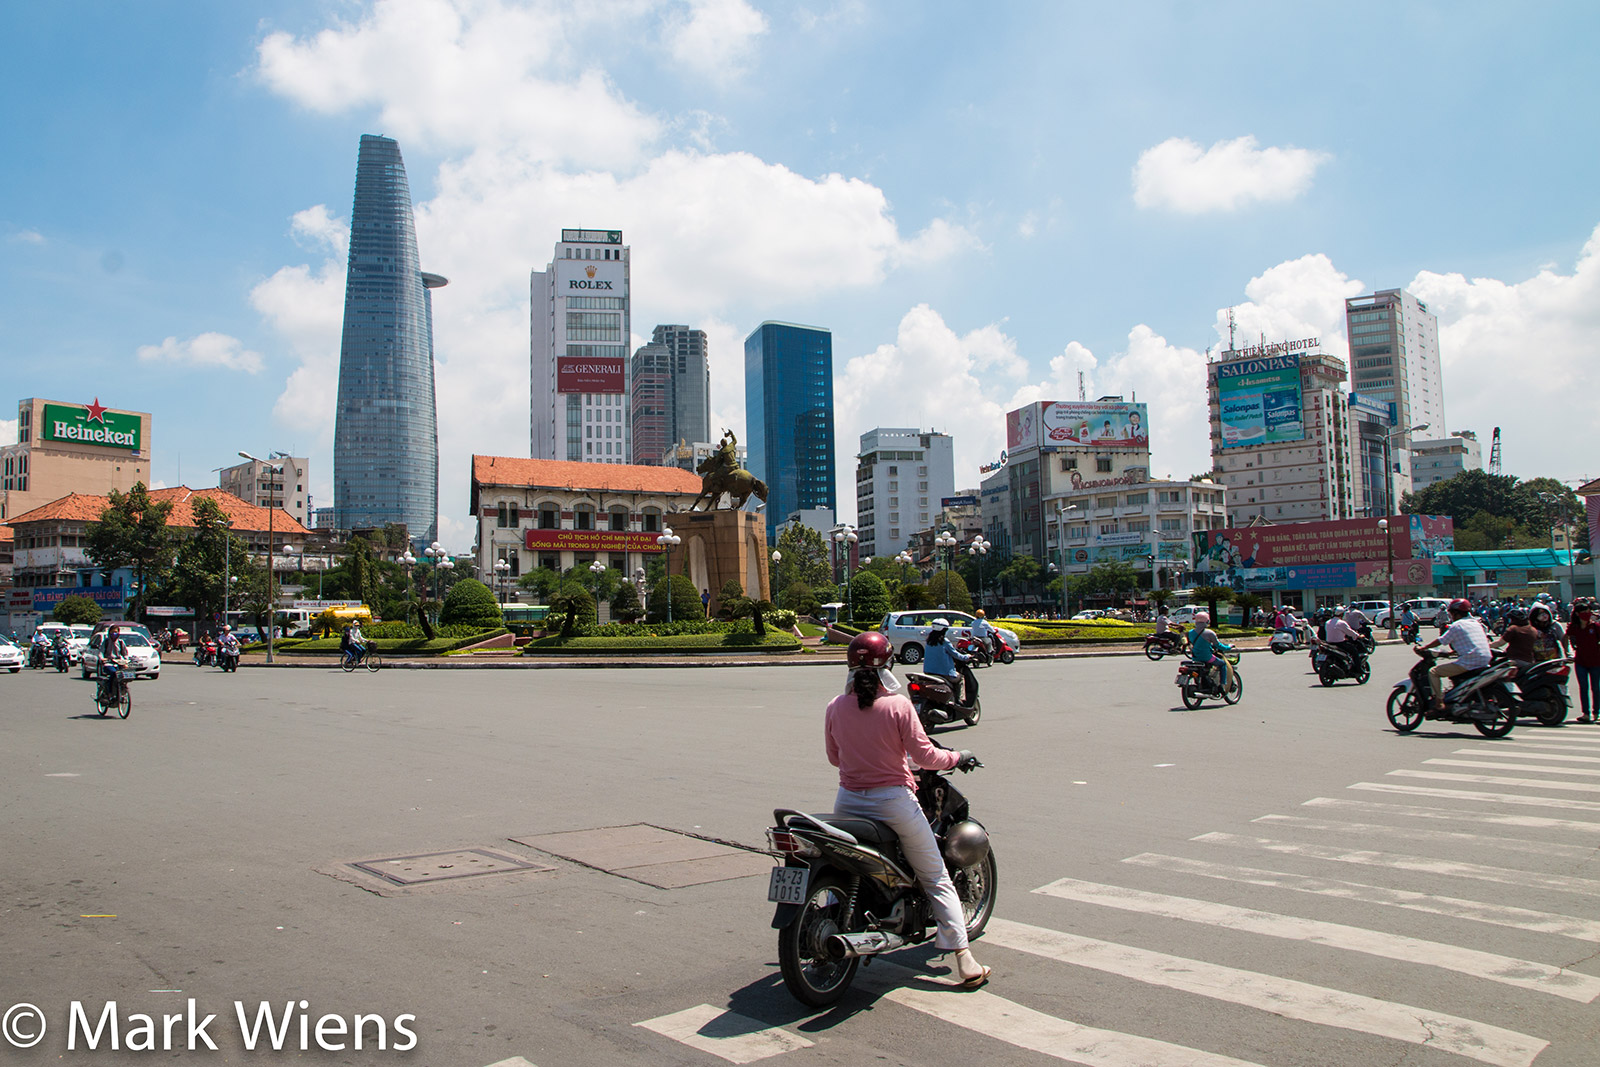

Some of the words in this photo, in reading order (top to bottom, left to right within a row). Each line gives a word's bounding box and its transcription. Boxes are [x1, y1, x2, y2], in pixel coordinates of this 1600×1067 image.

[569, 279, 613, 290] ROLEX
[1290, 338, 1320, 350] HOTEL
[575, 364, 621, 374] GENERALI
[1221, 356, 1295, 377] SALONPAS
[1224, 403, 1260, 414] Salonpas
[1267, 409, 1296, 419] Salonpas
[54, 420, 135, 446] Heineken
[1122, 546, 1144, 555] freeze
[775, 869, 803, 885] 54-Z3
[774, 884, 801, 900] 1015
